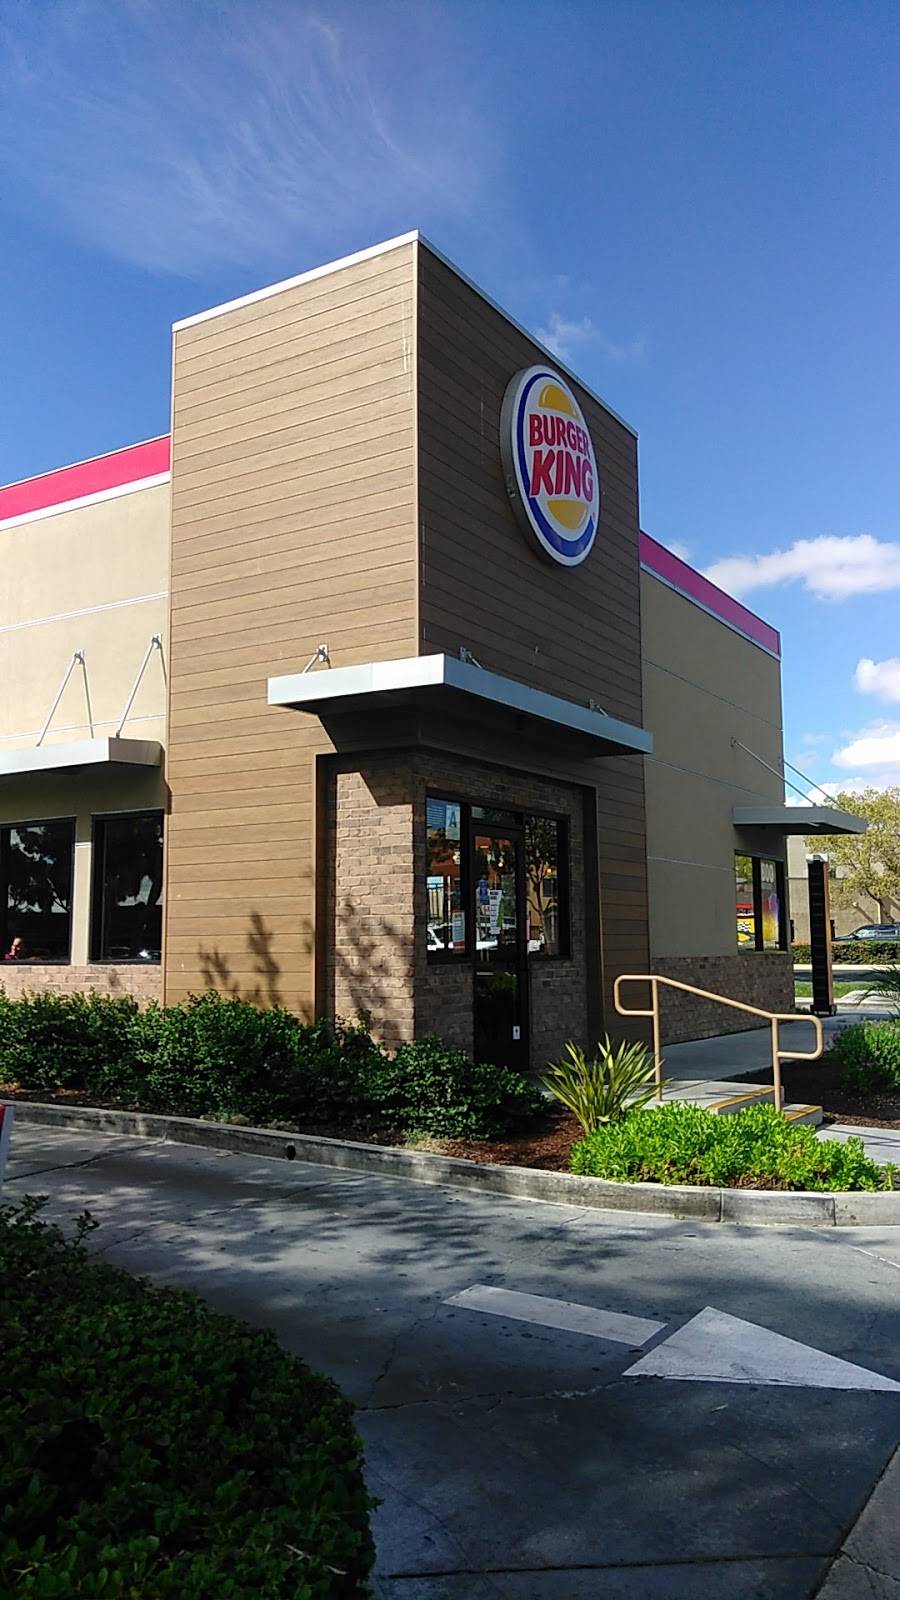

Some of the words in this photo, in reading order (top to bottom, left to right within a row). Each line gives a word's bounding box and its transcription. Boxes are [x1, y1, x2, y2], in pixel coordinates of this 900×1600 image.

[529, 414, 590, 460] BURGER
[531, 450, 593, 503] KING
[448, 811, 457, 828] A
